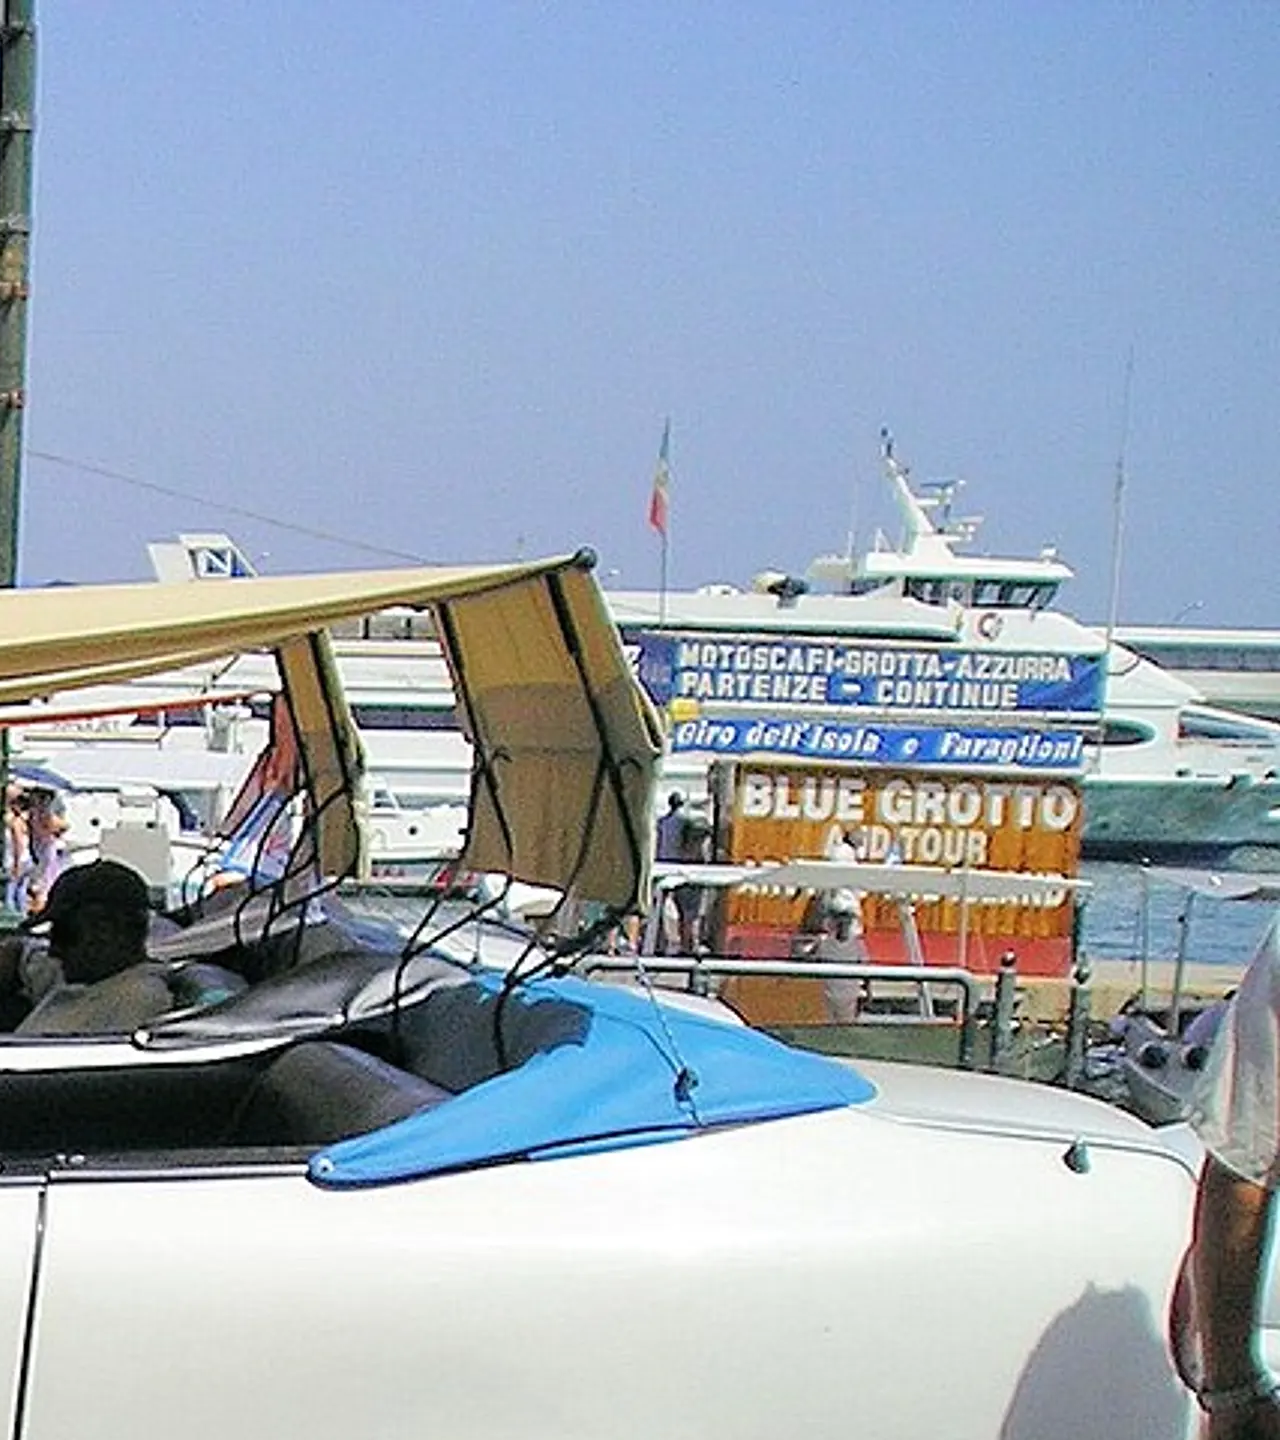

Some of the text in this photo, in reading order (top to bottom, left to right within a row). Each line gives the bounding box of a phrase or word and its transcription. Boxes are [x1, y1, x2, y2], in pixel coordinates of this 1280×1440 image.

[682, 671, 828, 701] PARTENZE
[876, 679, 1019, 708] CONTINUE
[676, 720, 736, 746] Giro
[940, 731, 1084, 763] Faraglioni
[742, 772, 1078, 831] BLUE GROTTO
[899, 827, 989, 865] TOUR
